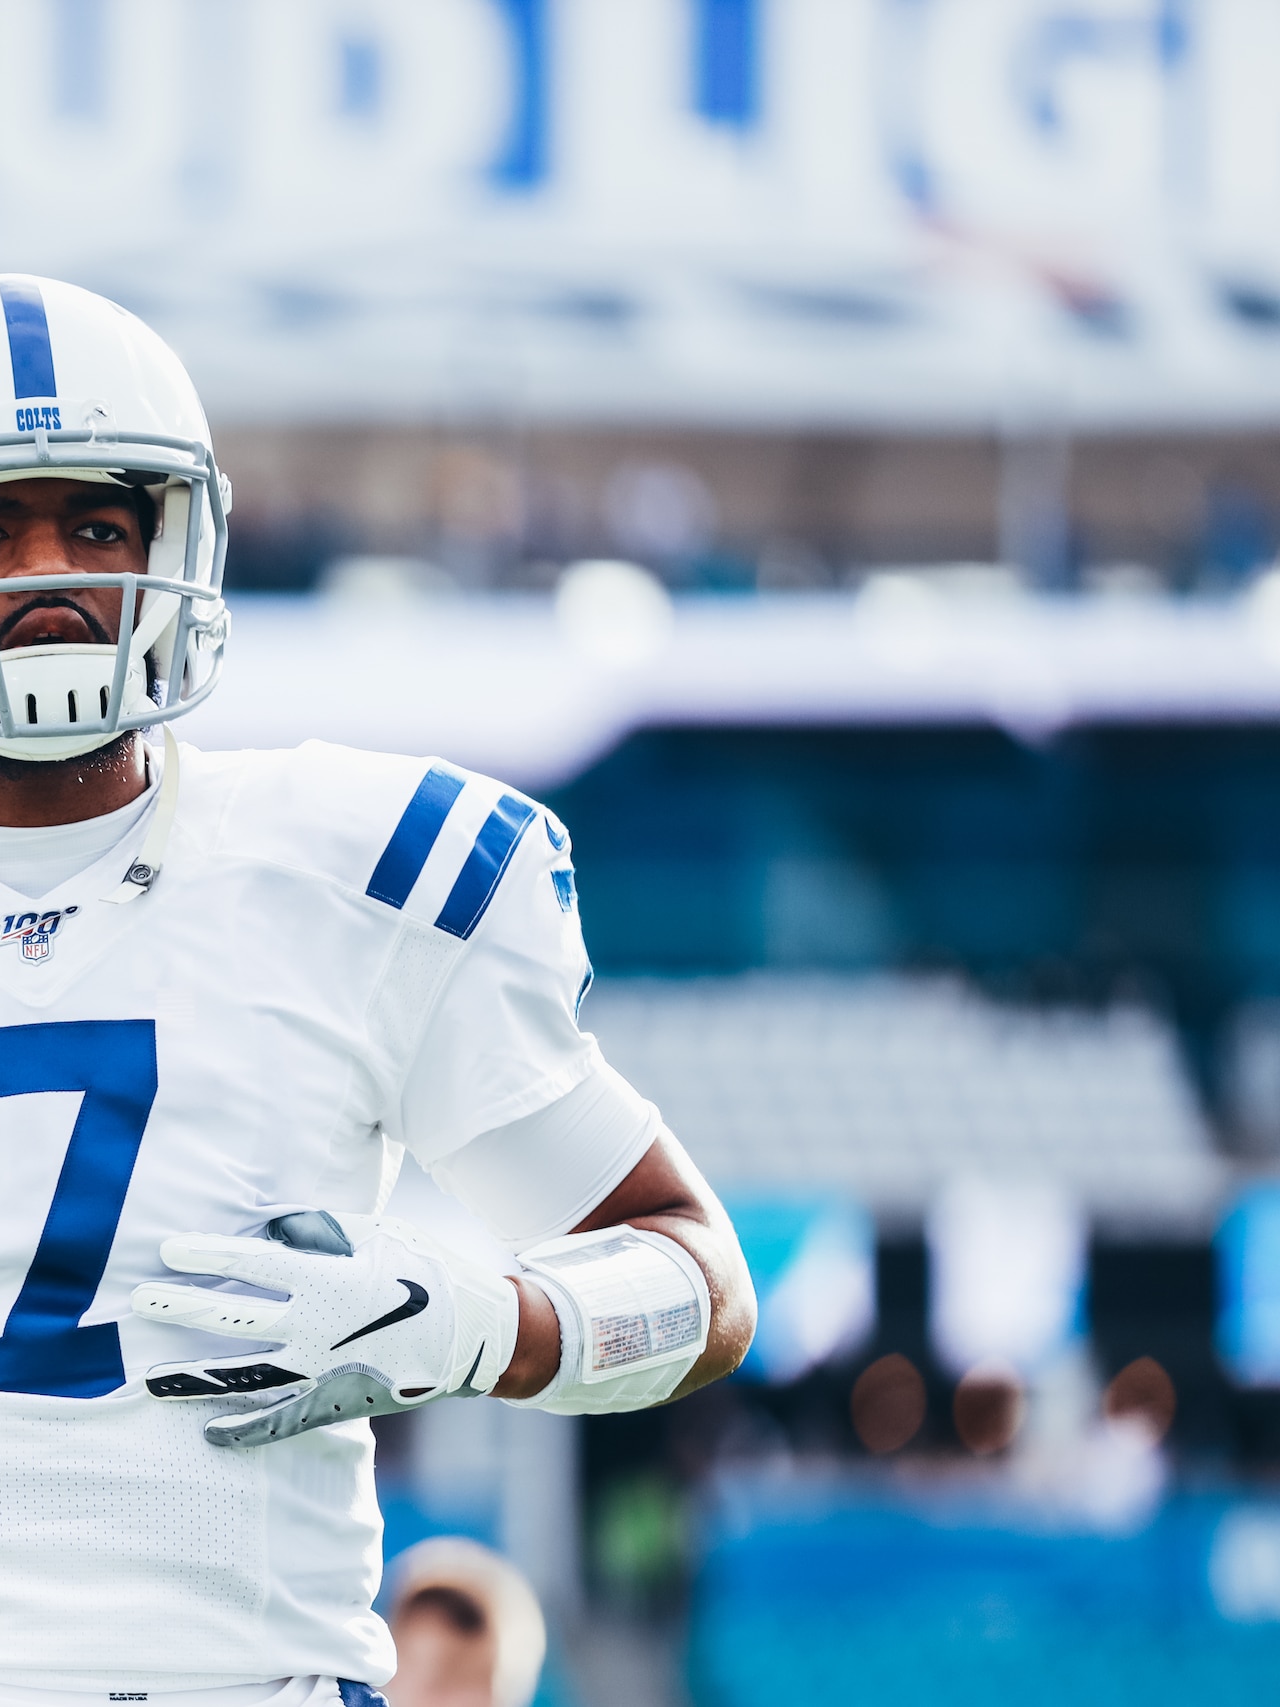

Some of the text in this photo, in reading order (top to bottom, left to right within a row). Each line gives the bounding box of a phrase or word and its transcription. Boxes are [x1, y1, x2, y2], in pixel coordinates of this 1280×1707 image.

[16, 407, 61, 431] COLTS
[3, 911, 61, 938] 100
[25, 944, 47, 957] NFL
